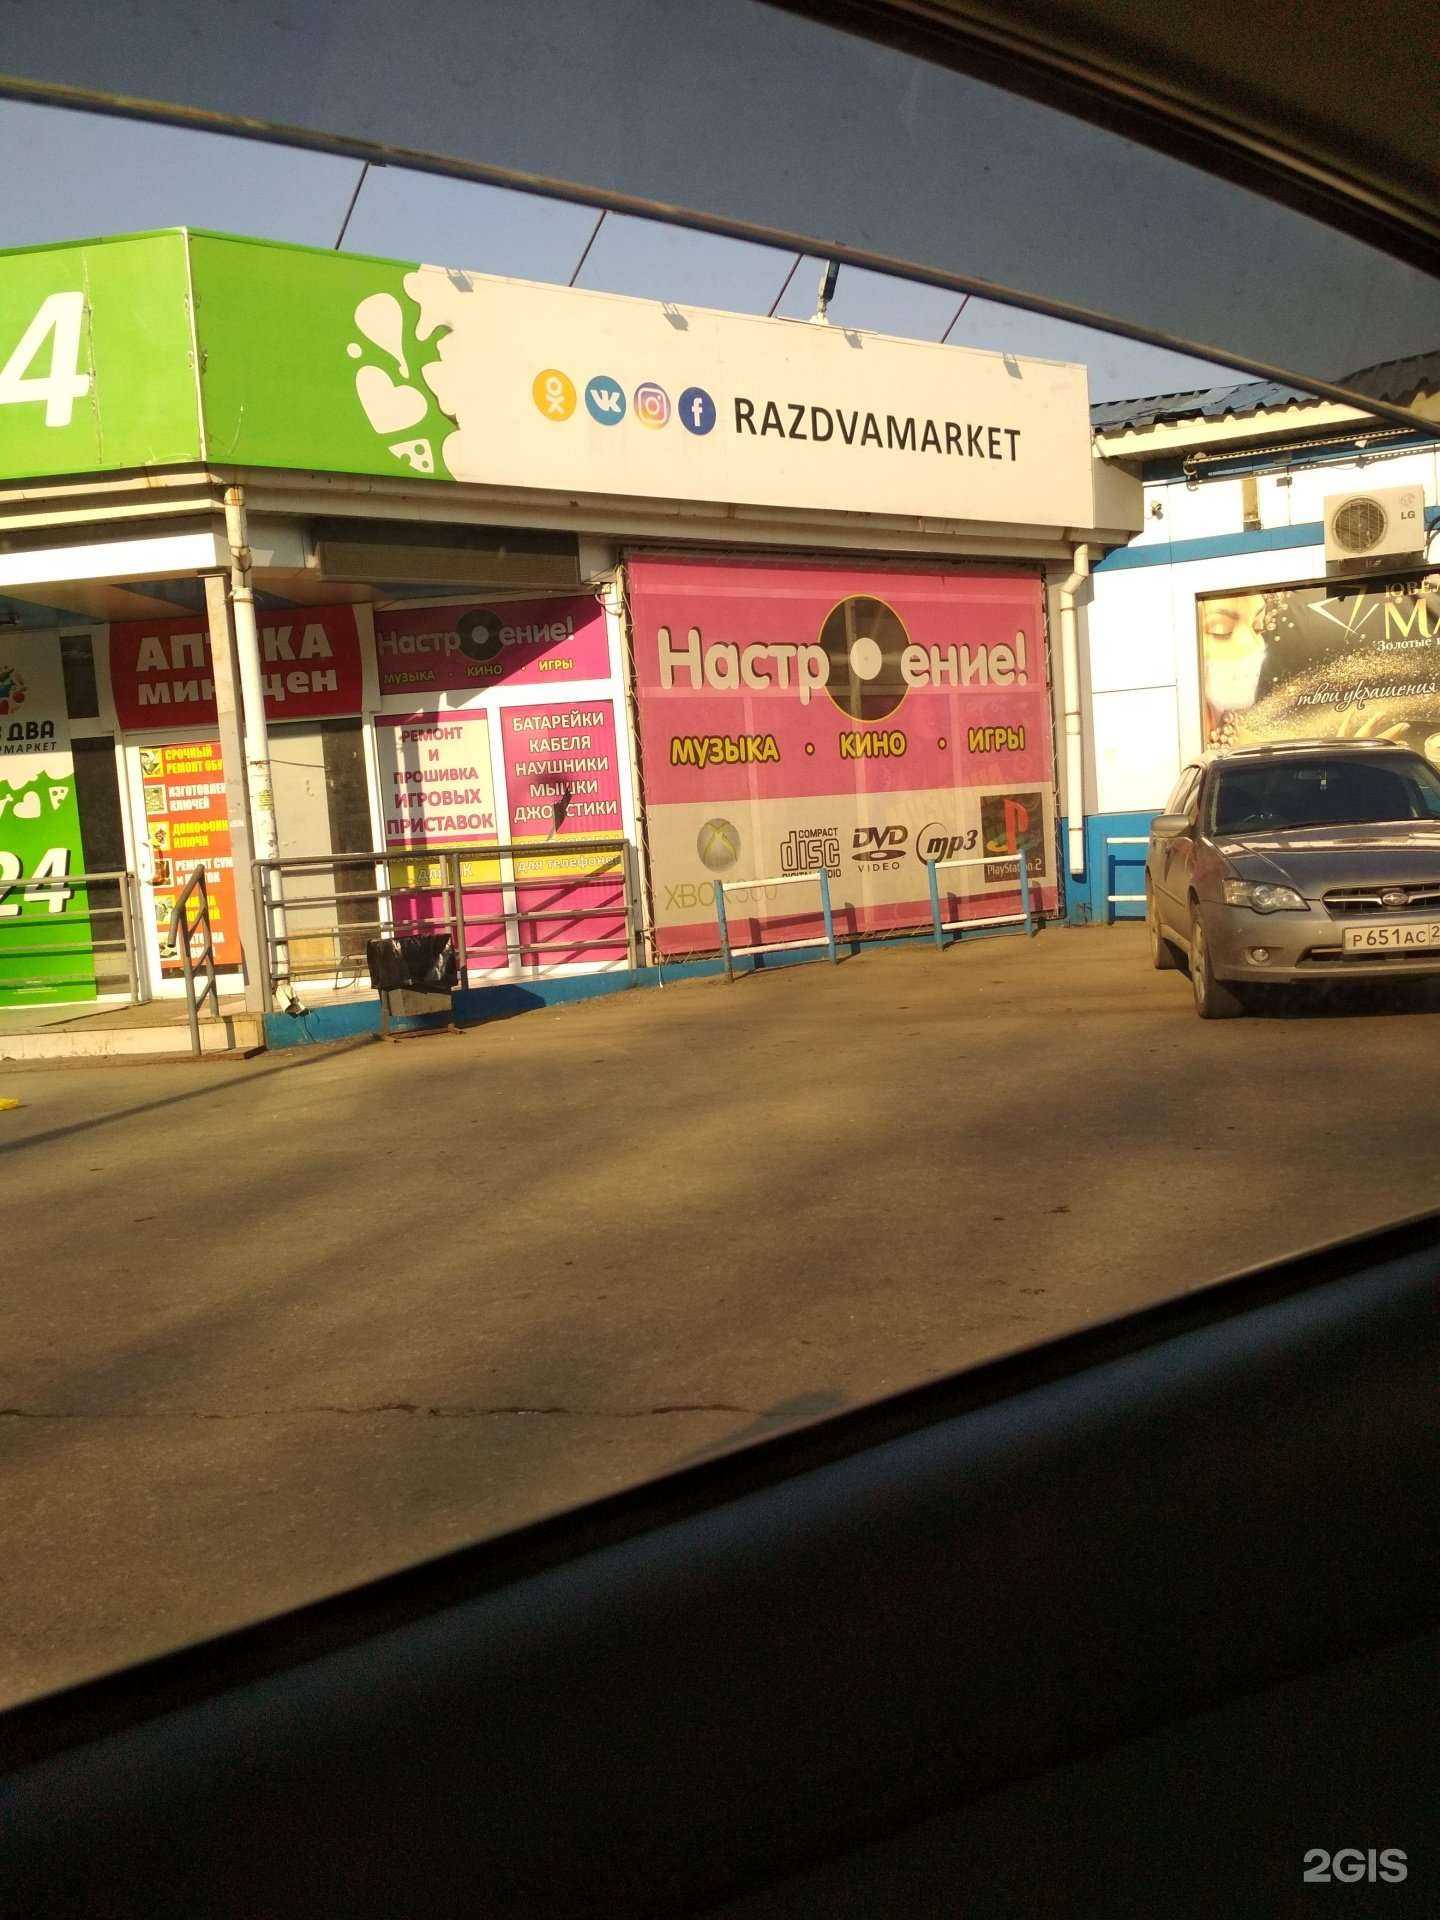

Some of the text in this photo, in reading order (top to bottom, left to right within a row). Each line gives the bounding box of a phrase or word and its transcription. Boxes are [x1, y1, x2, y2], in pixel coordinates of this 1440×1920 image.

[734, 397, 1021, 461] RAZDVAMARKET
[1401, 510, 1416, 520] LG
[1384, 597, 1440, 640] М
[136, 623, 334, 672] АПКА
[1376, 638, 1432, 652] Золотые
[465, 663, 503, 677] КИНО
[538, 658, 576, 672] ИГРЫ
[1297, 680, 1438, 713] твои украшения
[6, 720, 55, 741] ДВА
[512, 709, 604, 733] БАТАРЕЙКИ
[402, 727, 463, 742] РЕМОНТ
[529, 735, 591, 753] КАБЕЛЯ
[839, 730, 907, 760] КИНО
[968, 725, 1025, 753] ИГРЫ
[0, 741, 57, 754] МАРКЕТ
[428, 749, 440, 761] И
[205, 759, 223, 771] ОБУ
[515, 757, 609, 776] НАУШНИКИ
[393, 767, 479, 784] ПРОШИВКА
[395, 788, 482, 808] ИГРОВЫХ
[514, 801, 618, 824] ДЖОСТИКИ
[387, 813, 494, 834] ПРИСТАВОК
[798, 827, 838, 838] COMPACT
[853, 824, 909, 849] DVD
[922, 827, 979, 865] mp3
[858, 861, 900, 873] VIDEO
[1035, 858, 1042, 871] 2
